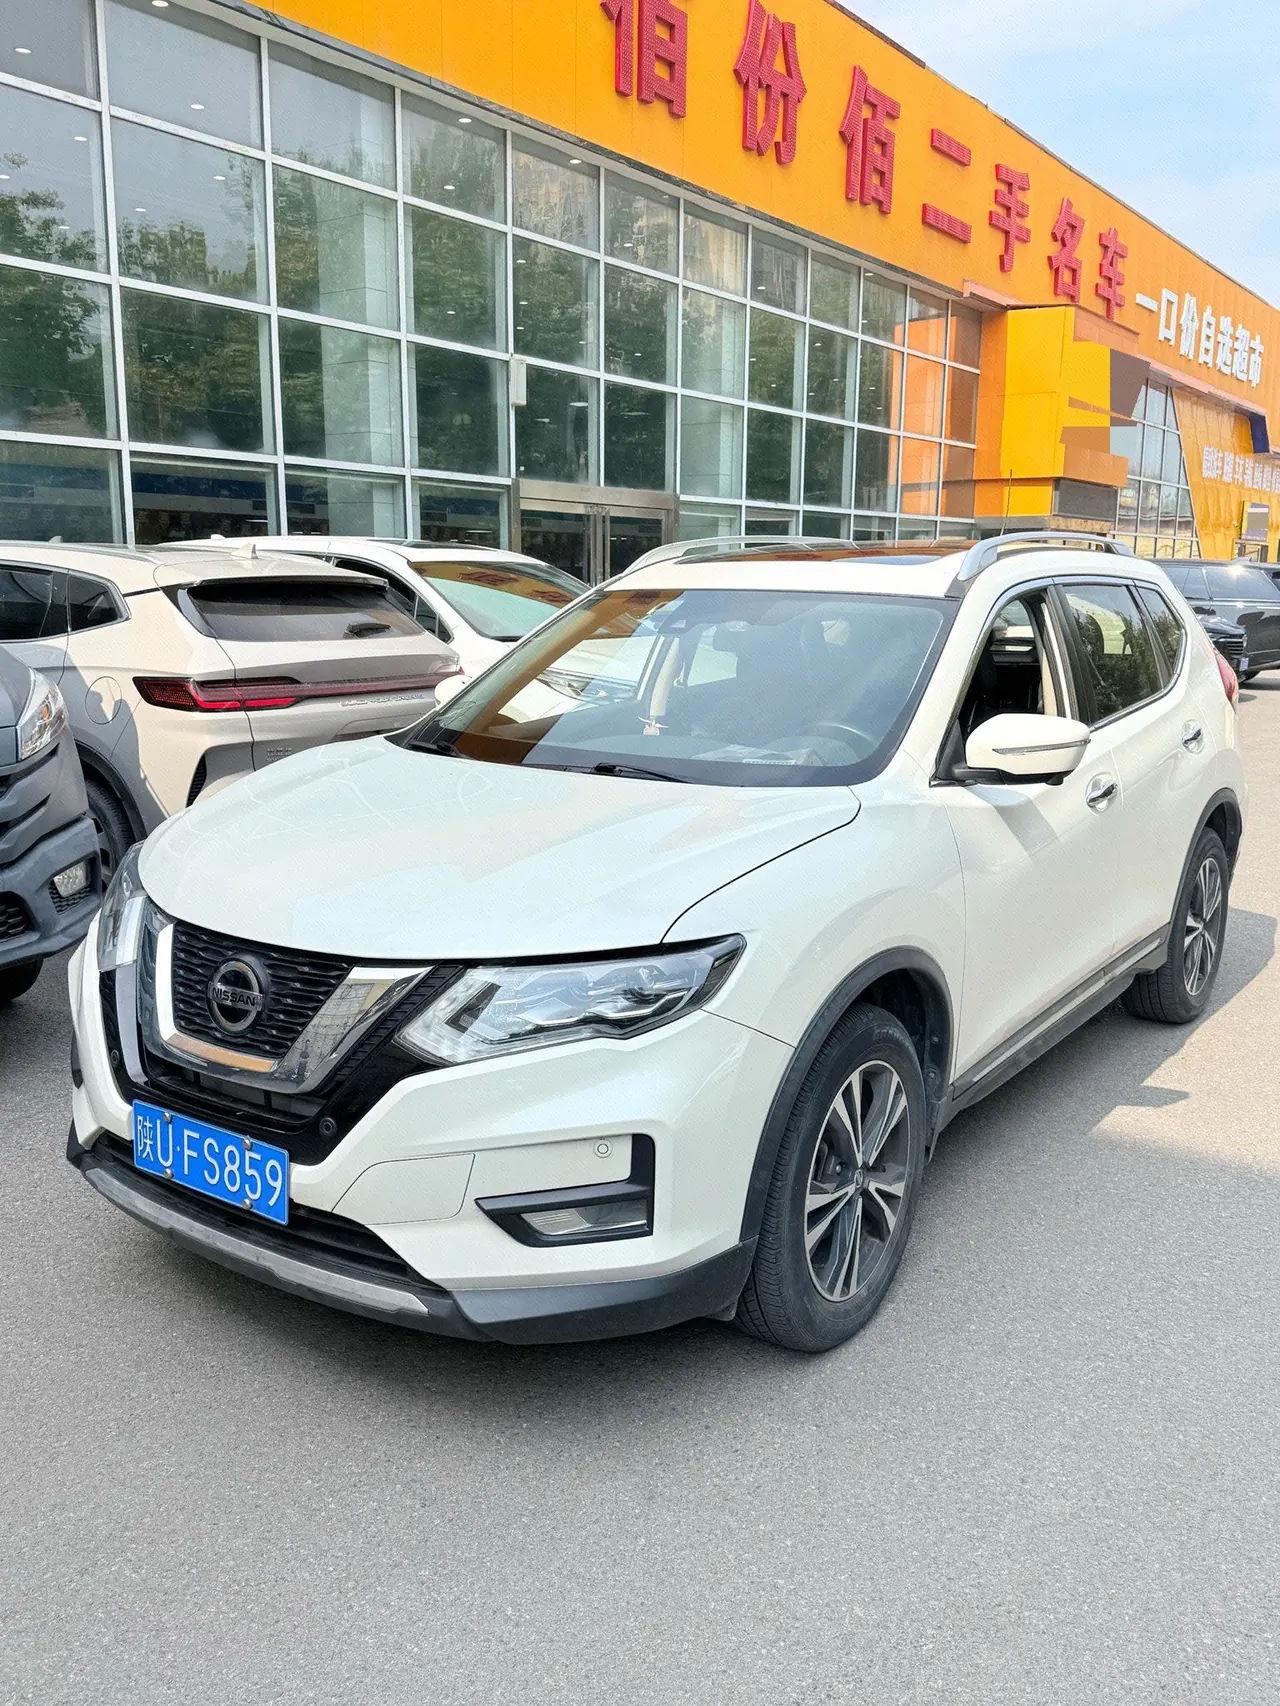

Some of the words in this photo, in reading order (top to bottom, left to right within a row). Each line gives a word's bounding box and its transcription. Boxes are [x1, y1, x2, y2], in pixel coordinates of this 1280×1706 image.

[1135, 287, 1265, 388] 一口价自选超市
[212, 986, 256, 1007] NISSAN
